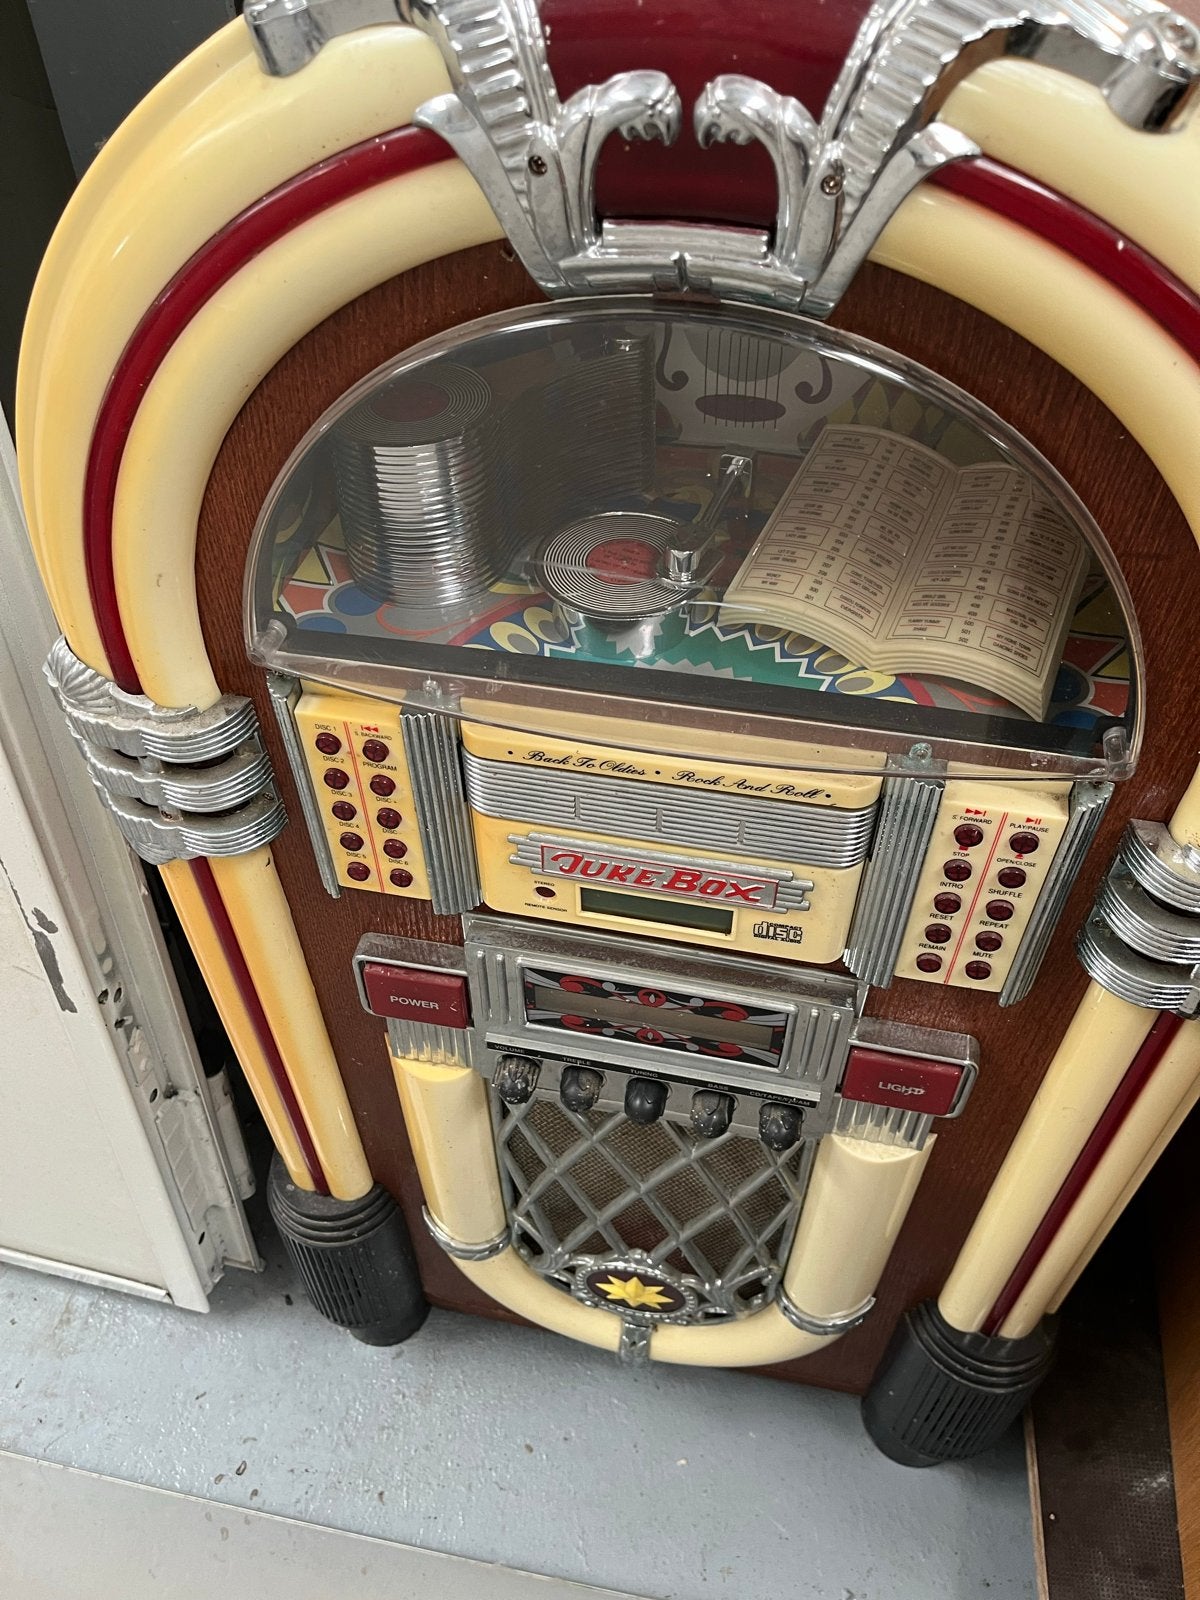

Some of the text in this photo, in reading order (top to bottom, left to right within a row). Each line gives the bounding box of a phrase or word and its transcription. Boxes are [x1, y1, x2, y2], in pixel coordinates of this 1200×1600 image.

[315, 723, 331, 732] DISC
[362, 761, 397, 771] PROGRAM
[523, 750, 825, 799] Back To Oldies Rock And Roll
[958, 815, 992, 825] FORWARD
[1009, 822, 1050, 833] PLAY/PAUSE
[550, 851, 766, 902] JUKE BOX
[939, 881, 964, 890] INTRO
[987, 888, 1023, 899] SHUFFLE
[929, 912, 954, 921] RESET
[979, 920, 1009, 930] REPEAT
[918, 943, 947, 951] REMAIN
[972, 951, 994, 959] MUTE
[390, 995, 439, 1010] POWER
[494, 1044, 525, 1054] VOLUME
[630, 1068, 659, 1078] TUNING
[707, 1082, 729, 1091] BASS
